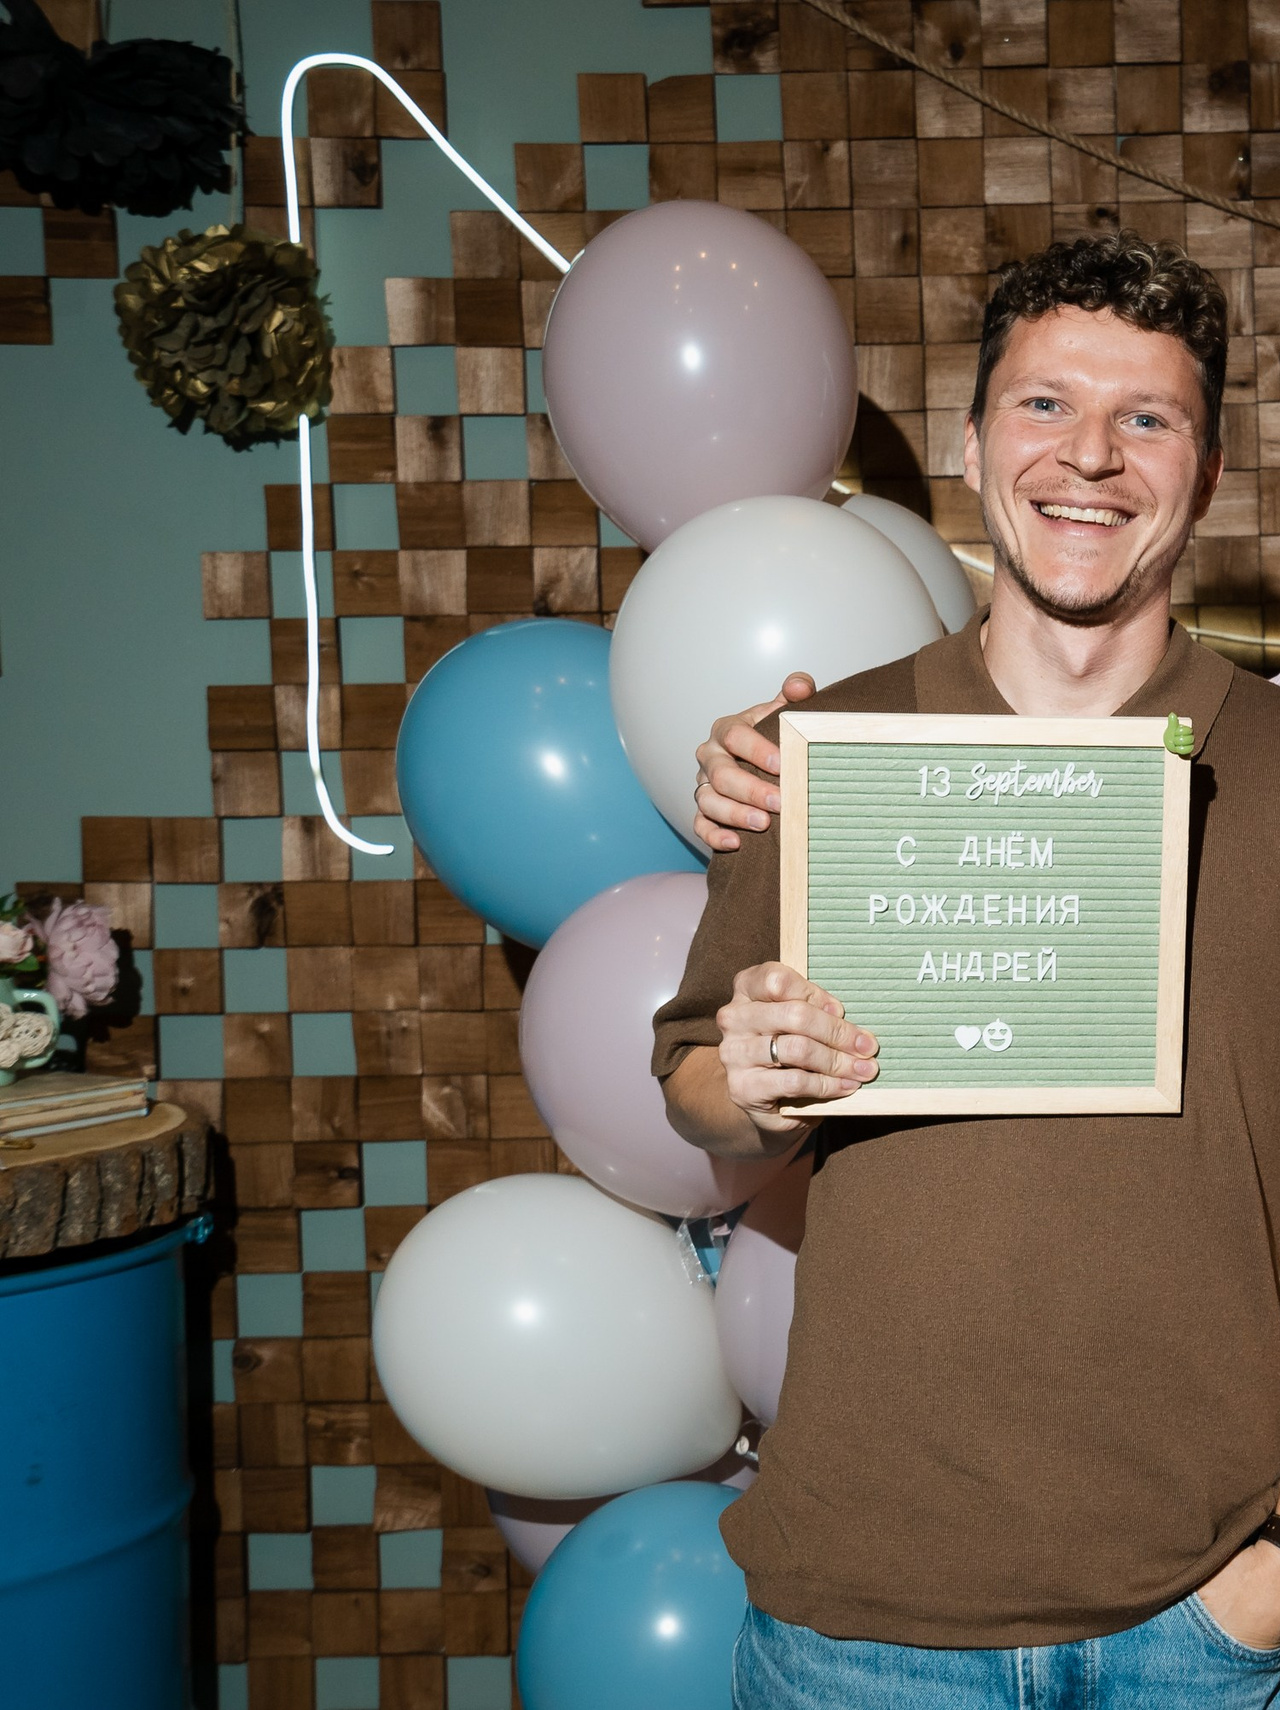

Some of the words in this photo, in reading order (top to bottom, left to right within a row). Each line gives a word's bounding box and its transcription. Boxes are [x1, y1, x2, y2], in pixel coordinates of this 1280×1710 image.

[918, 765, 951, 799] 13
[966, 759, 1104, 806] September
[896, 835, 917, 868] С
[958, 831, 1054, 870] ДНЁМ
[868, 893, 1080, 926] РОЖДЕНИЯ
[916, 947, 1057, 984] АНДРЕЙ
